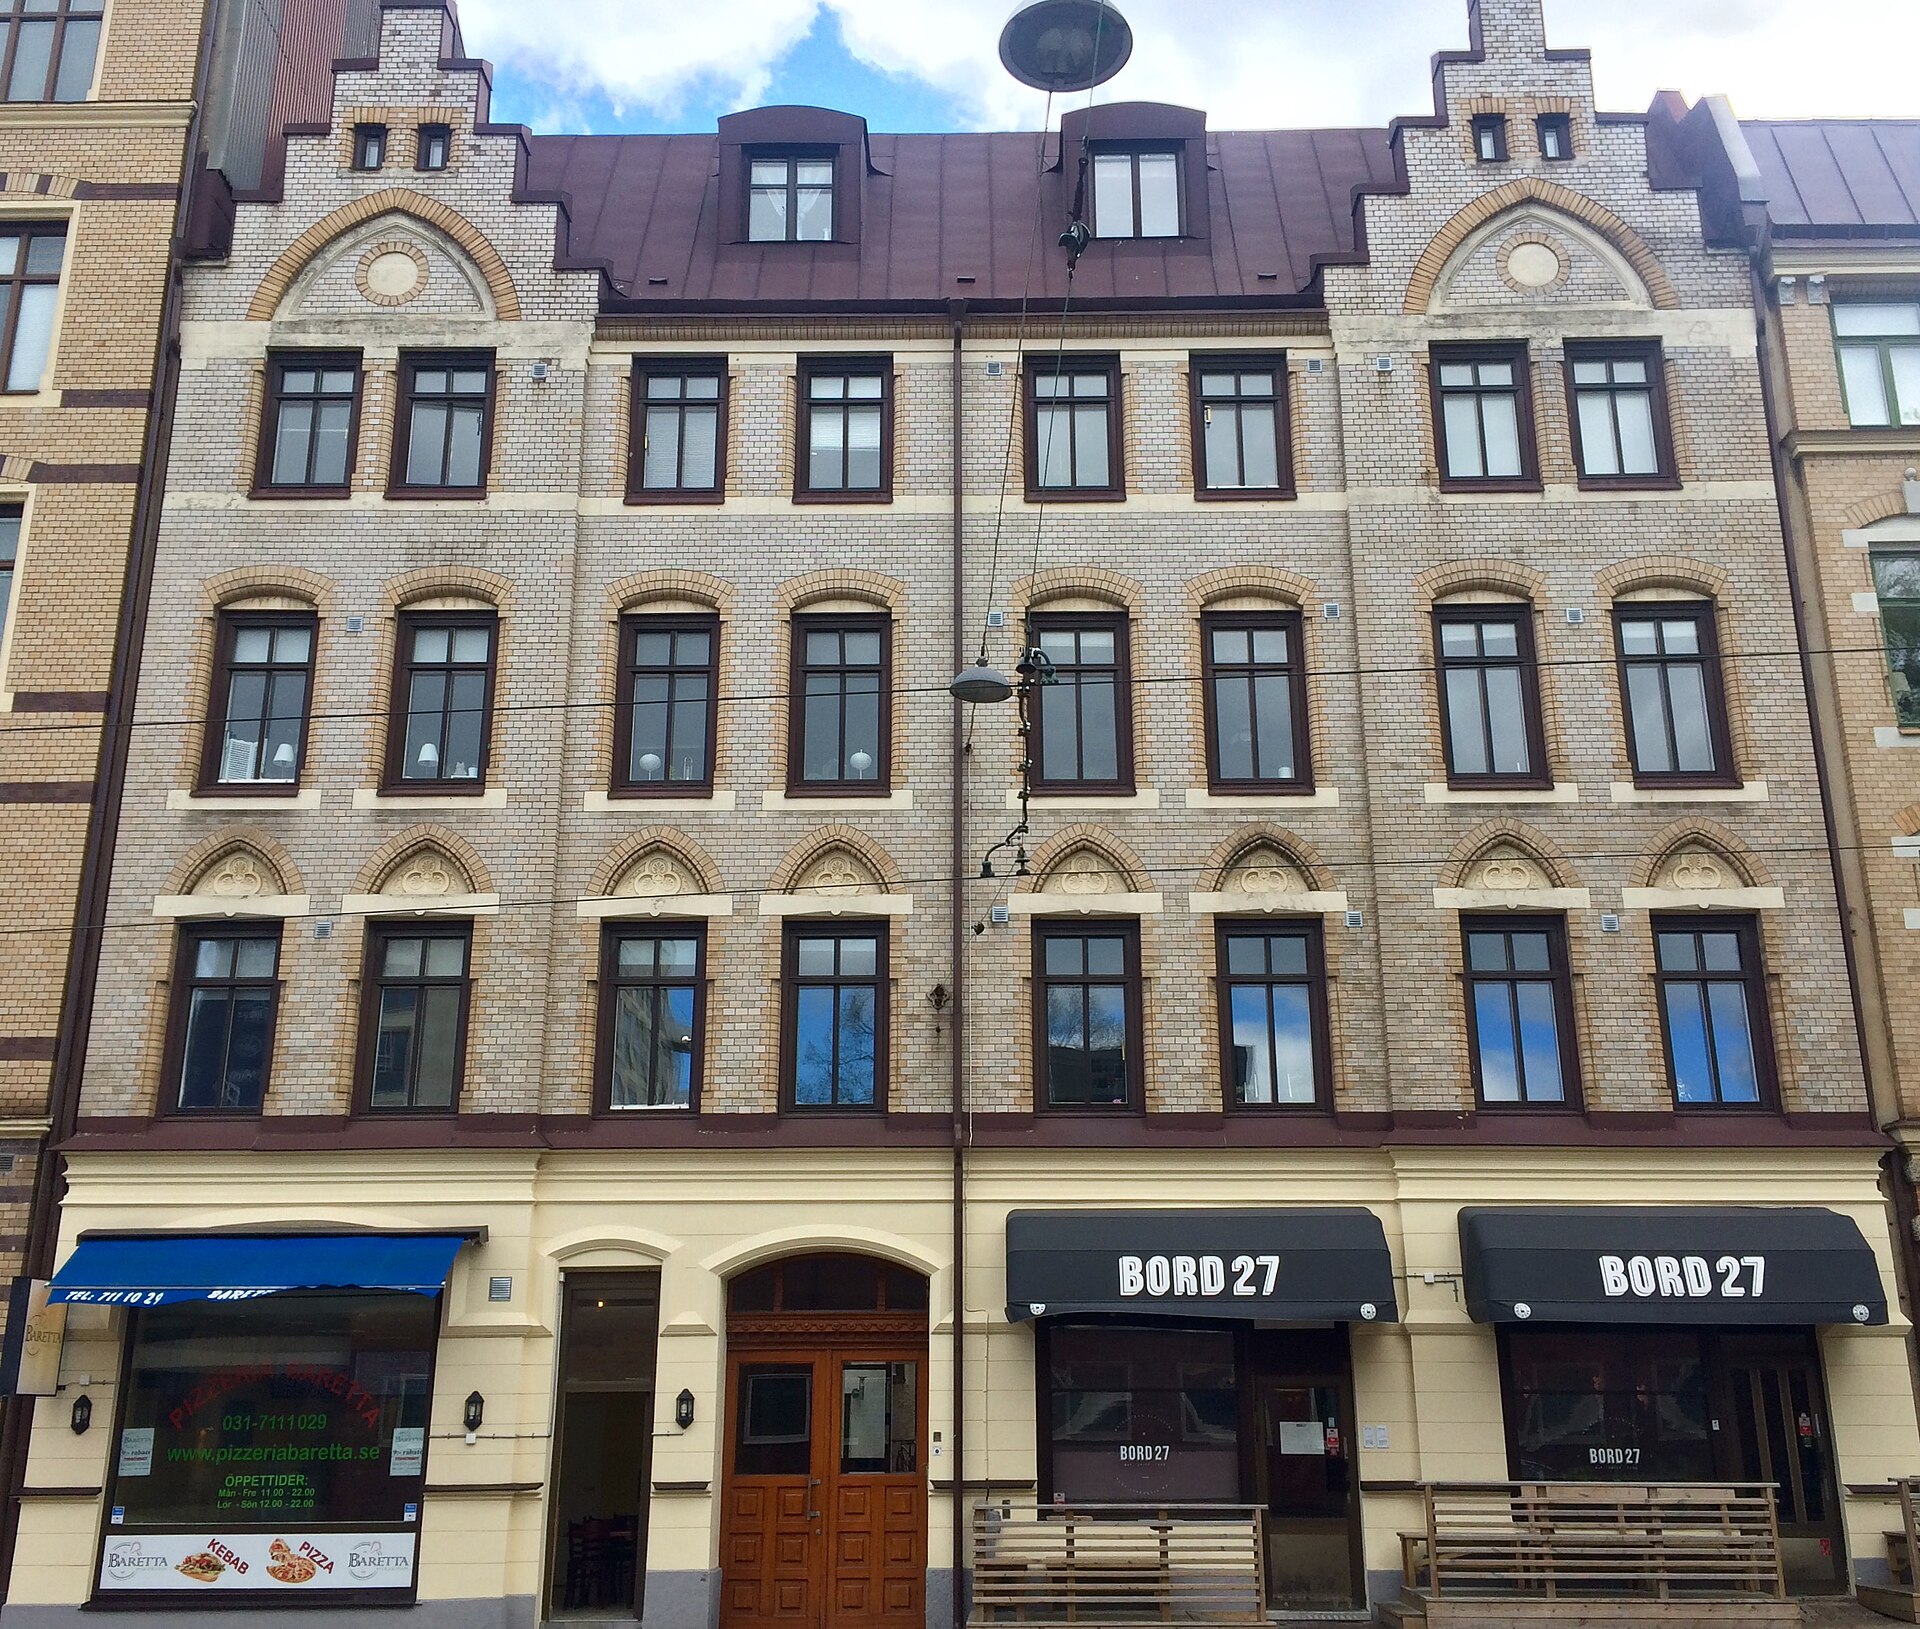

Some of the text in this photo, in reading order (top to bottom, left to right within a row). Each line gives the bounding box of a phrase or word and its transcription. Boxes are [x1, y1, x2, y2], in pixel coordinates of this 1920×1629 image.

[1118, 1255, 1280, 1296] BORD 27
[1598, 1255, 1765, 1297] BORD 27
[65, 1291, 164, 1305] TEL: 711 10 29
[168, 1360, 382, 1431] PIZZERIA BARETTA
[222, 1414, 328, 1431] 031-7111029
[167, 1443, 380, 1465] www.pizzeriabaretta.se
[1120, 1445, 1170, 1461] BORD 27
[1589, 1448, 1640, 1464] BORD 27
[224, 1473, 309, 1487] ÖPPETTIDER:
[259, 1499, 283, 1509] 12.00
[290, 1499, 314, 1508] 22.00
[108, 1553, 168, 1568] BARETTA
[207, 1538, 250, 1575] KEBAB
[298, 1541, 335, 1575] PIZZA
[348, 1553, 409, 1568] BARETTA
